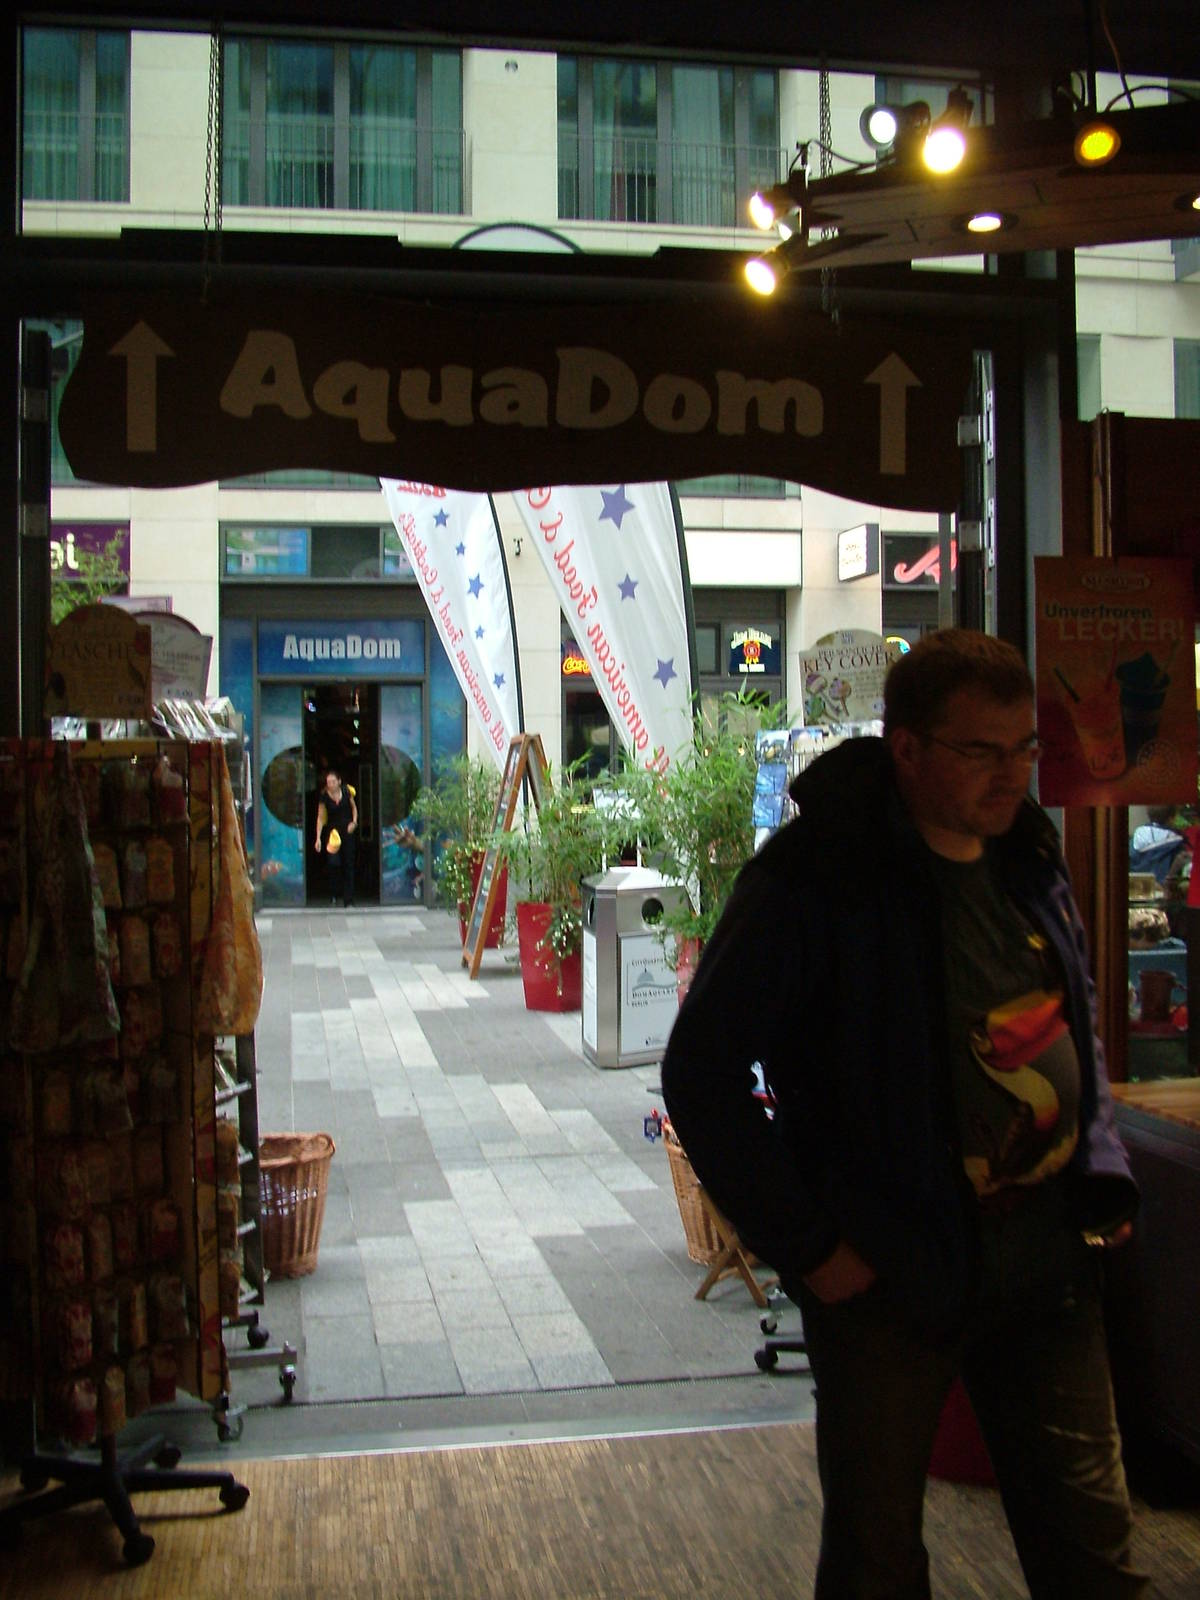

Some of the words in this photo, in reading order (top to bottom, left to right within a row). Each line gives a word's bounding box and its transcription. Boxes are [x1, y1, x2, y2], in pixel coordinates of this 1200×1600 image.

[220, 330, 824, 443] AquaDom
[1058, 617, 1185, 641] LECKER!
[283, 634, 401, 661] AquaDom
[803, 656, 833, 673] KEY
